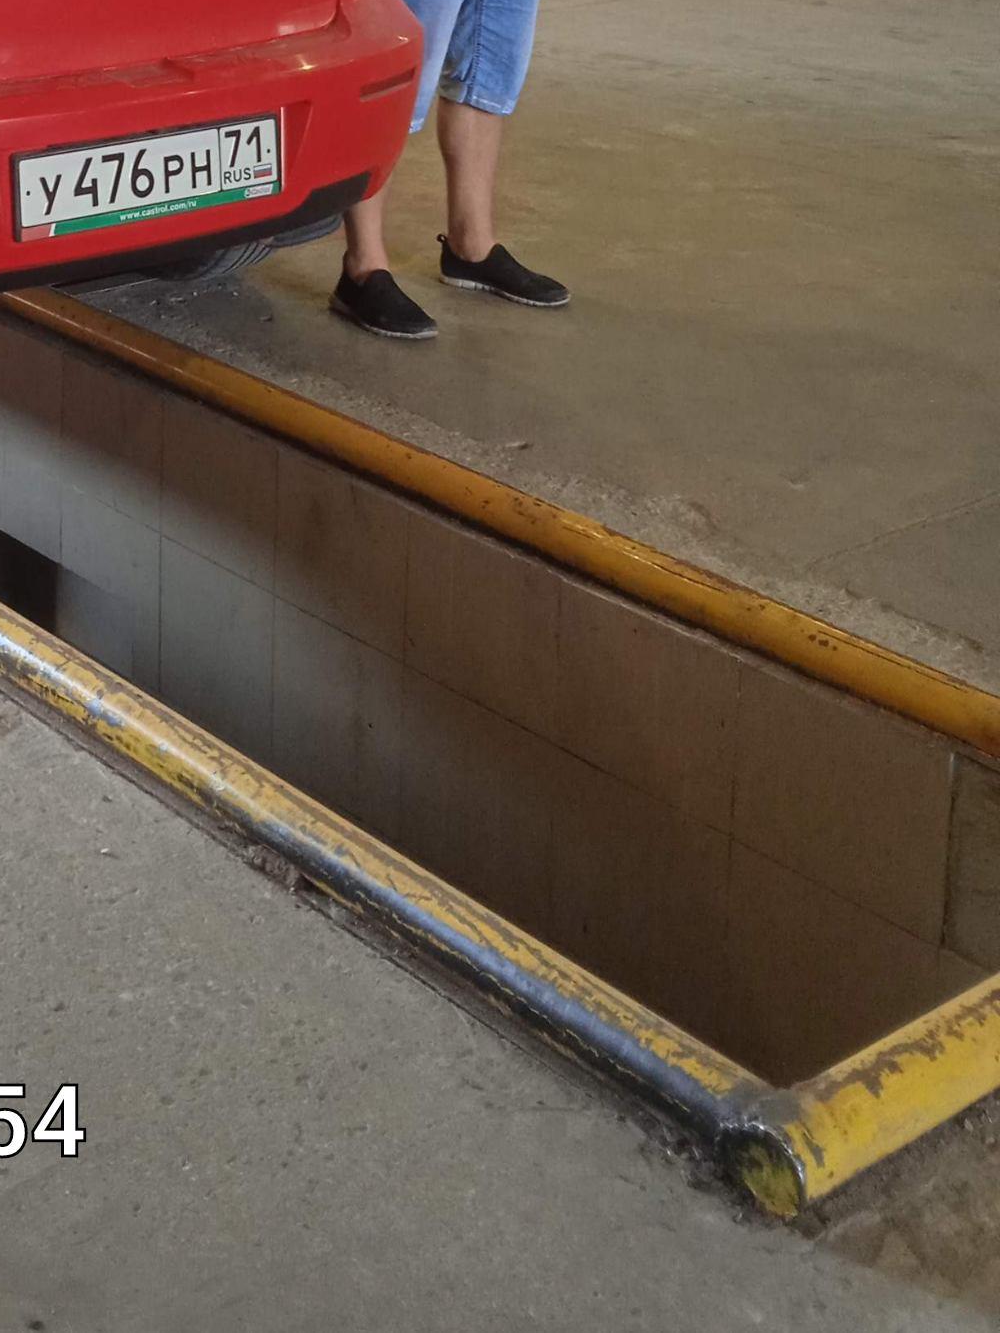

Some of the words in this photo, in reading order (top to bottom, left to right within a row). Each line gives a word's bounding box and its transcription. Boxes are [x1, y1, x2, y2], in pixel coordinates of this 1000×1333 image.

[39, 148, 212, 216] У476РН
[224, 126, 262, 168] 71
[223, 167, 252, 185] RUS
